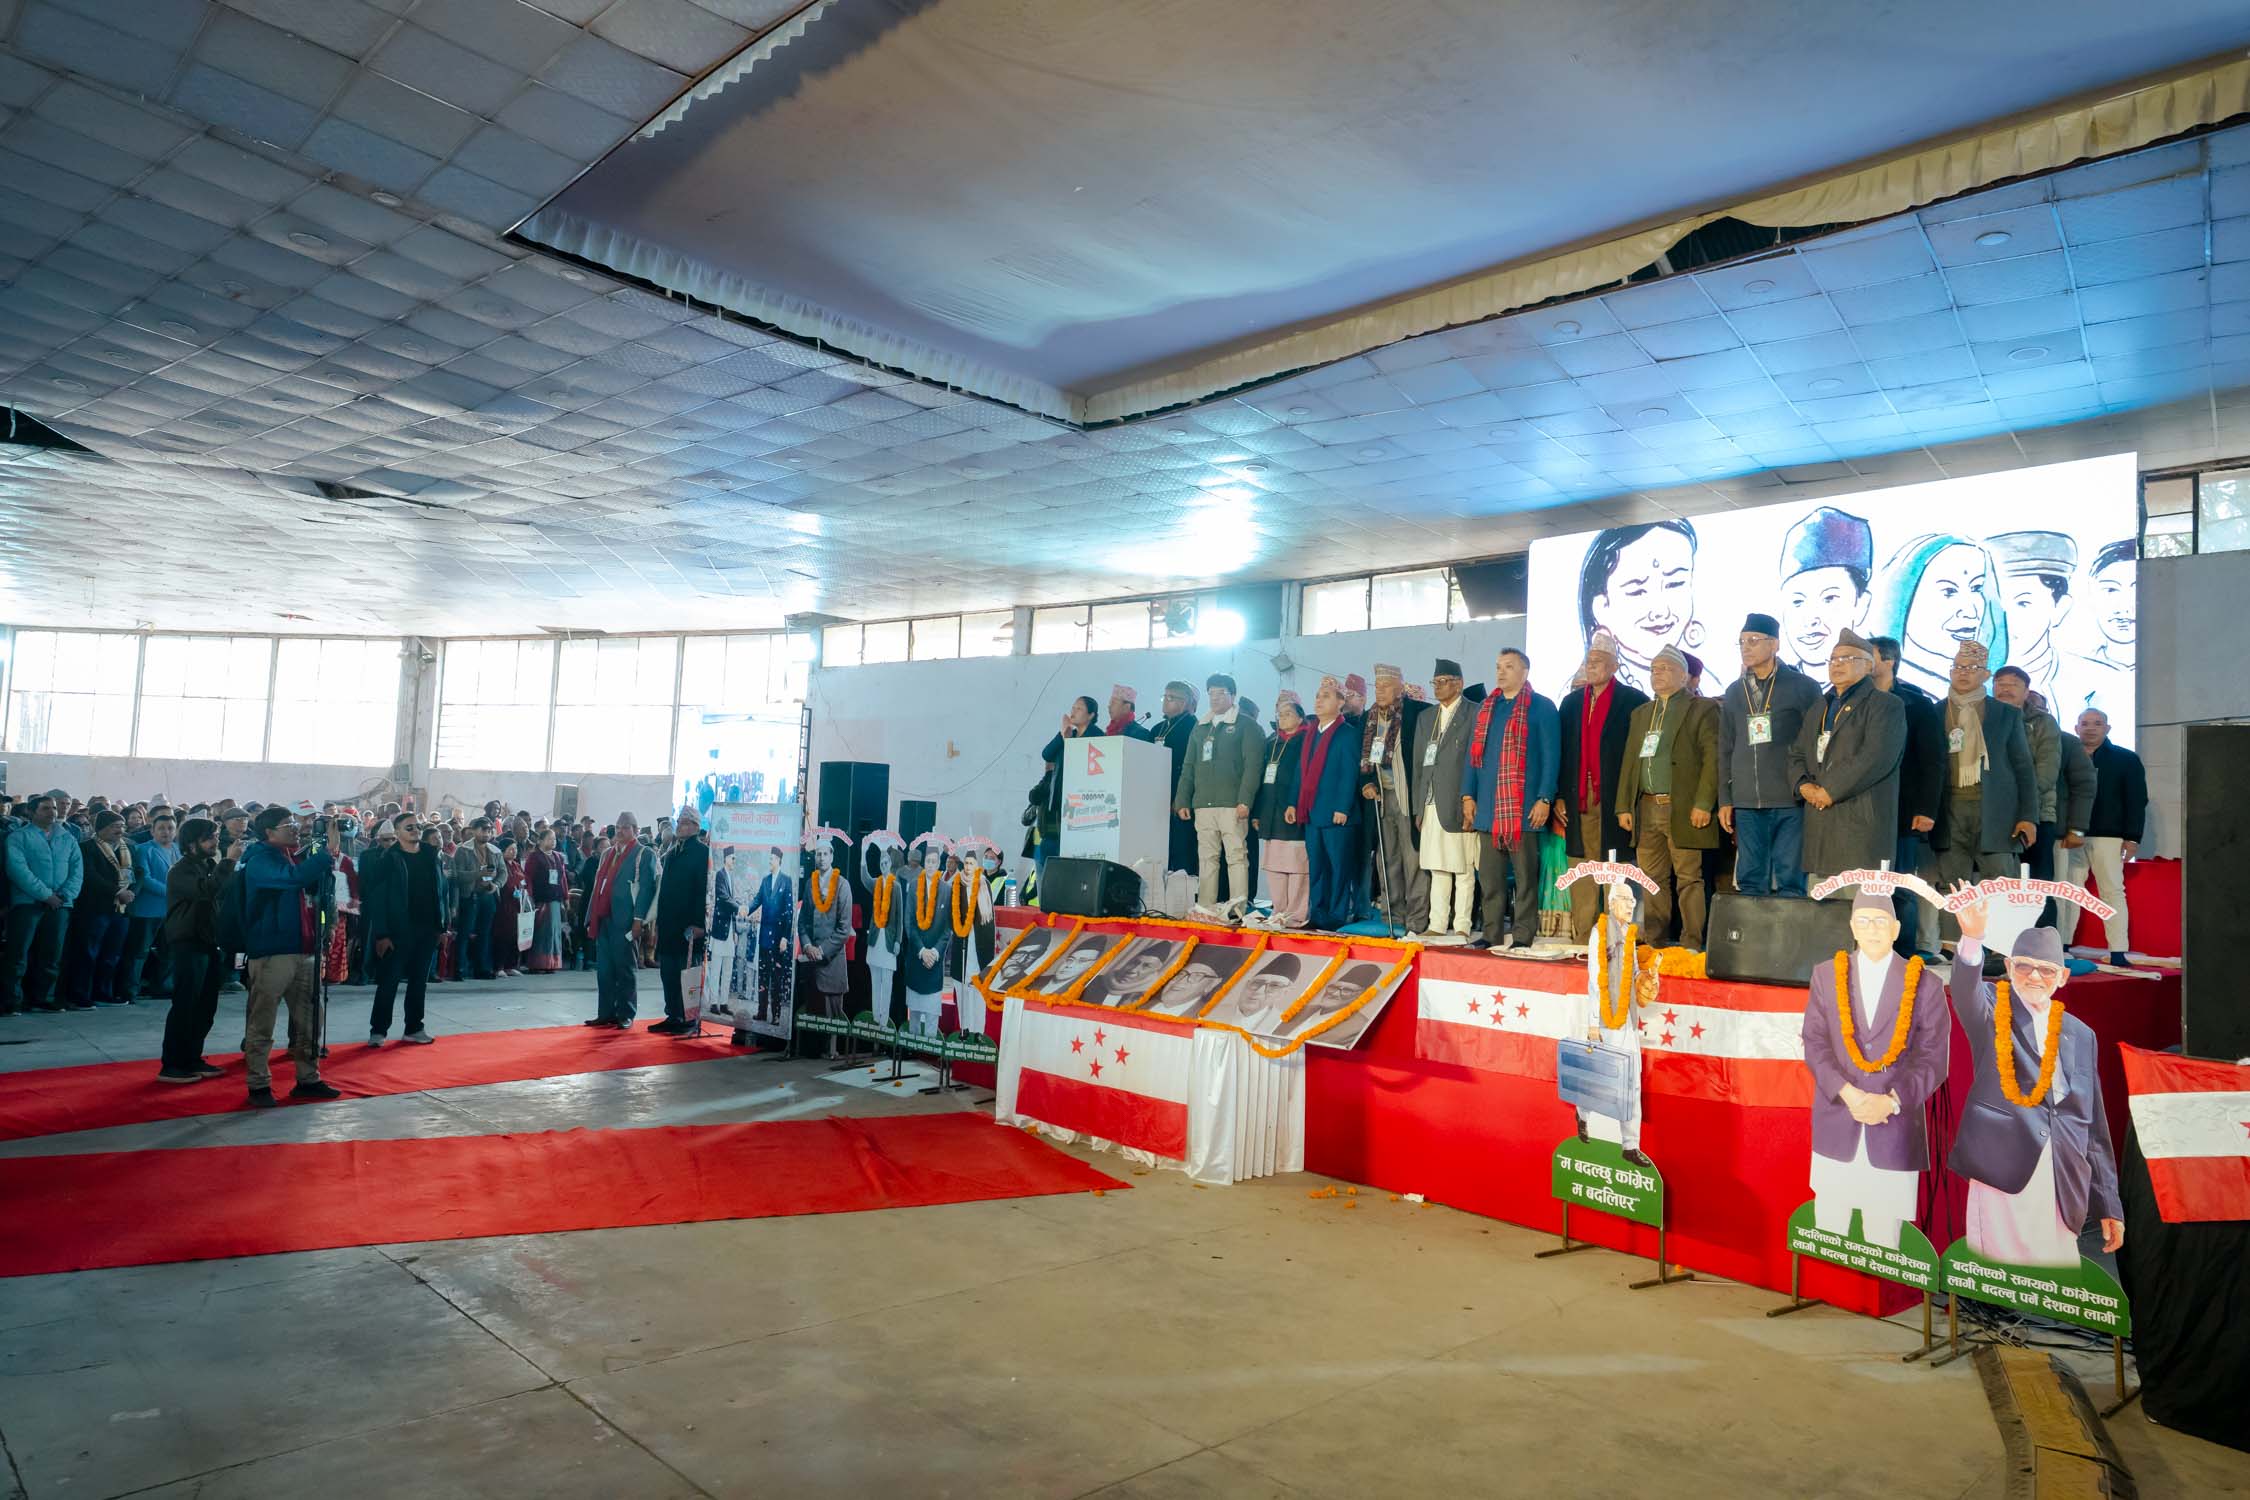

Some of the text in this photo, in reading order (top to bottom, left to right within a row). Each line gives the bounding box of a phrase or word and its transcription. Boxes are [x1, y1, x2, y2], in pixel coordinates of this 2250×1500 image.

[1574, 1159, 1612, 1184] बदल्छु
[1571, 1182, 1583, 1197] म
[1844, 1239, 1883, 1259] समयको
[1885, 1250, 1931, 1272] कांग्रेसका
[1869, 1259, 1899, 1277] देशका
[1981, 1283, 2017, 1304] बदल्नु
[2042, 1295, 2080, 1316] देशका
[2009, 1273, 2058, 1294] समयको
[2061, 1285, 2119, 1309] कांग्रेसका
